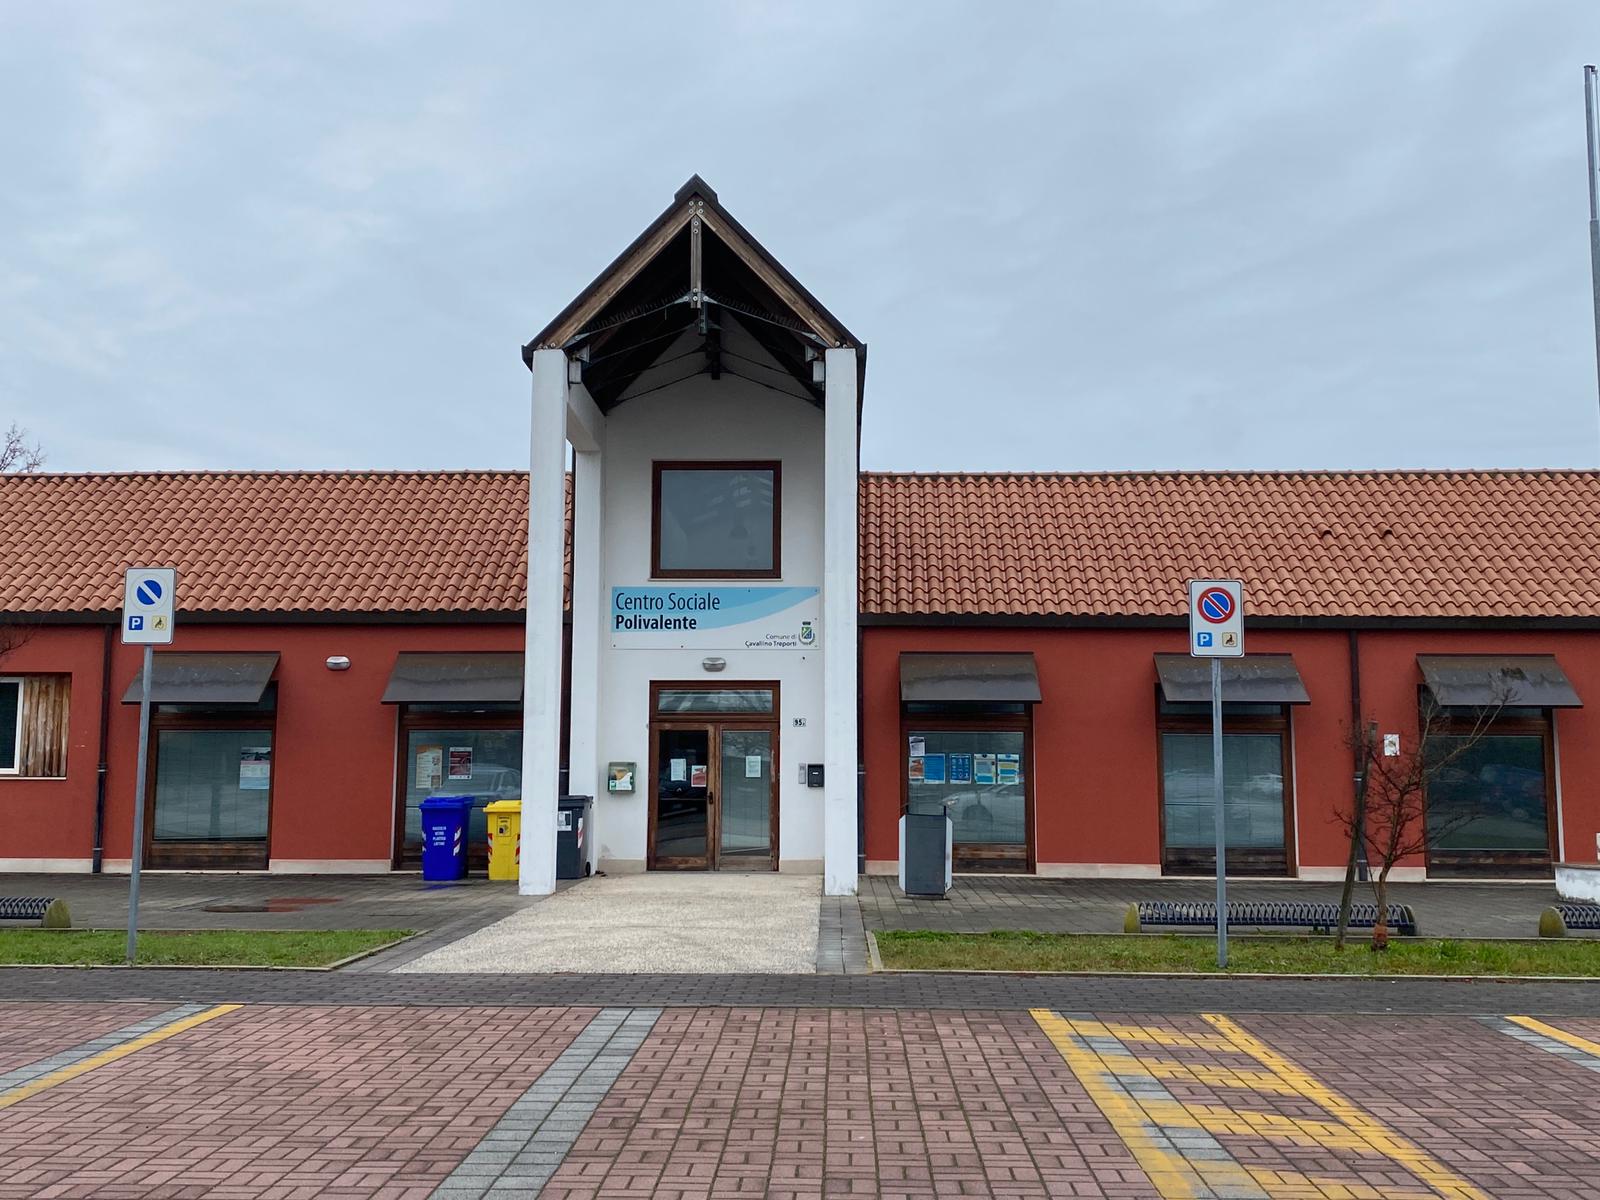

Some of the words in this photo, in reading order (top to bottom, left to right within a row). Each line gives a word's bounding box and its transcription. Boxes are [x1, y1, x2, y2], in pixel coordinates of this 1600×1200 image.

[616, 593, 664, 610] Centro
[668, 592, 720, 610] Sociale
[131, 617, 141, 629] P
[615, 614, 697, 630] Polivalente
[1200, 634, 1210, 646] P
